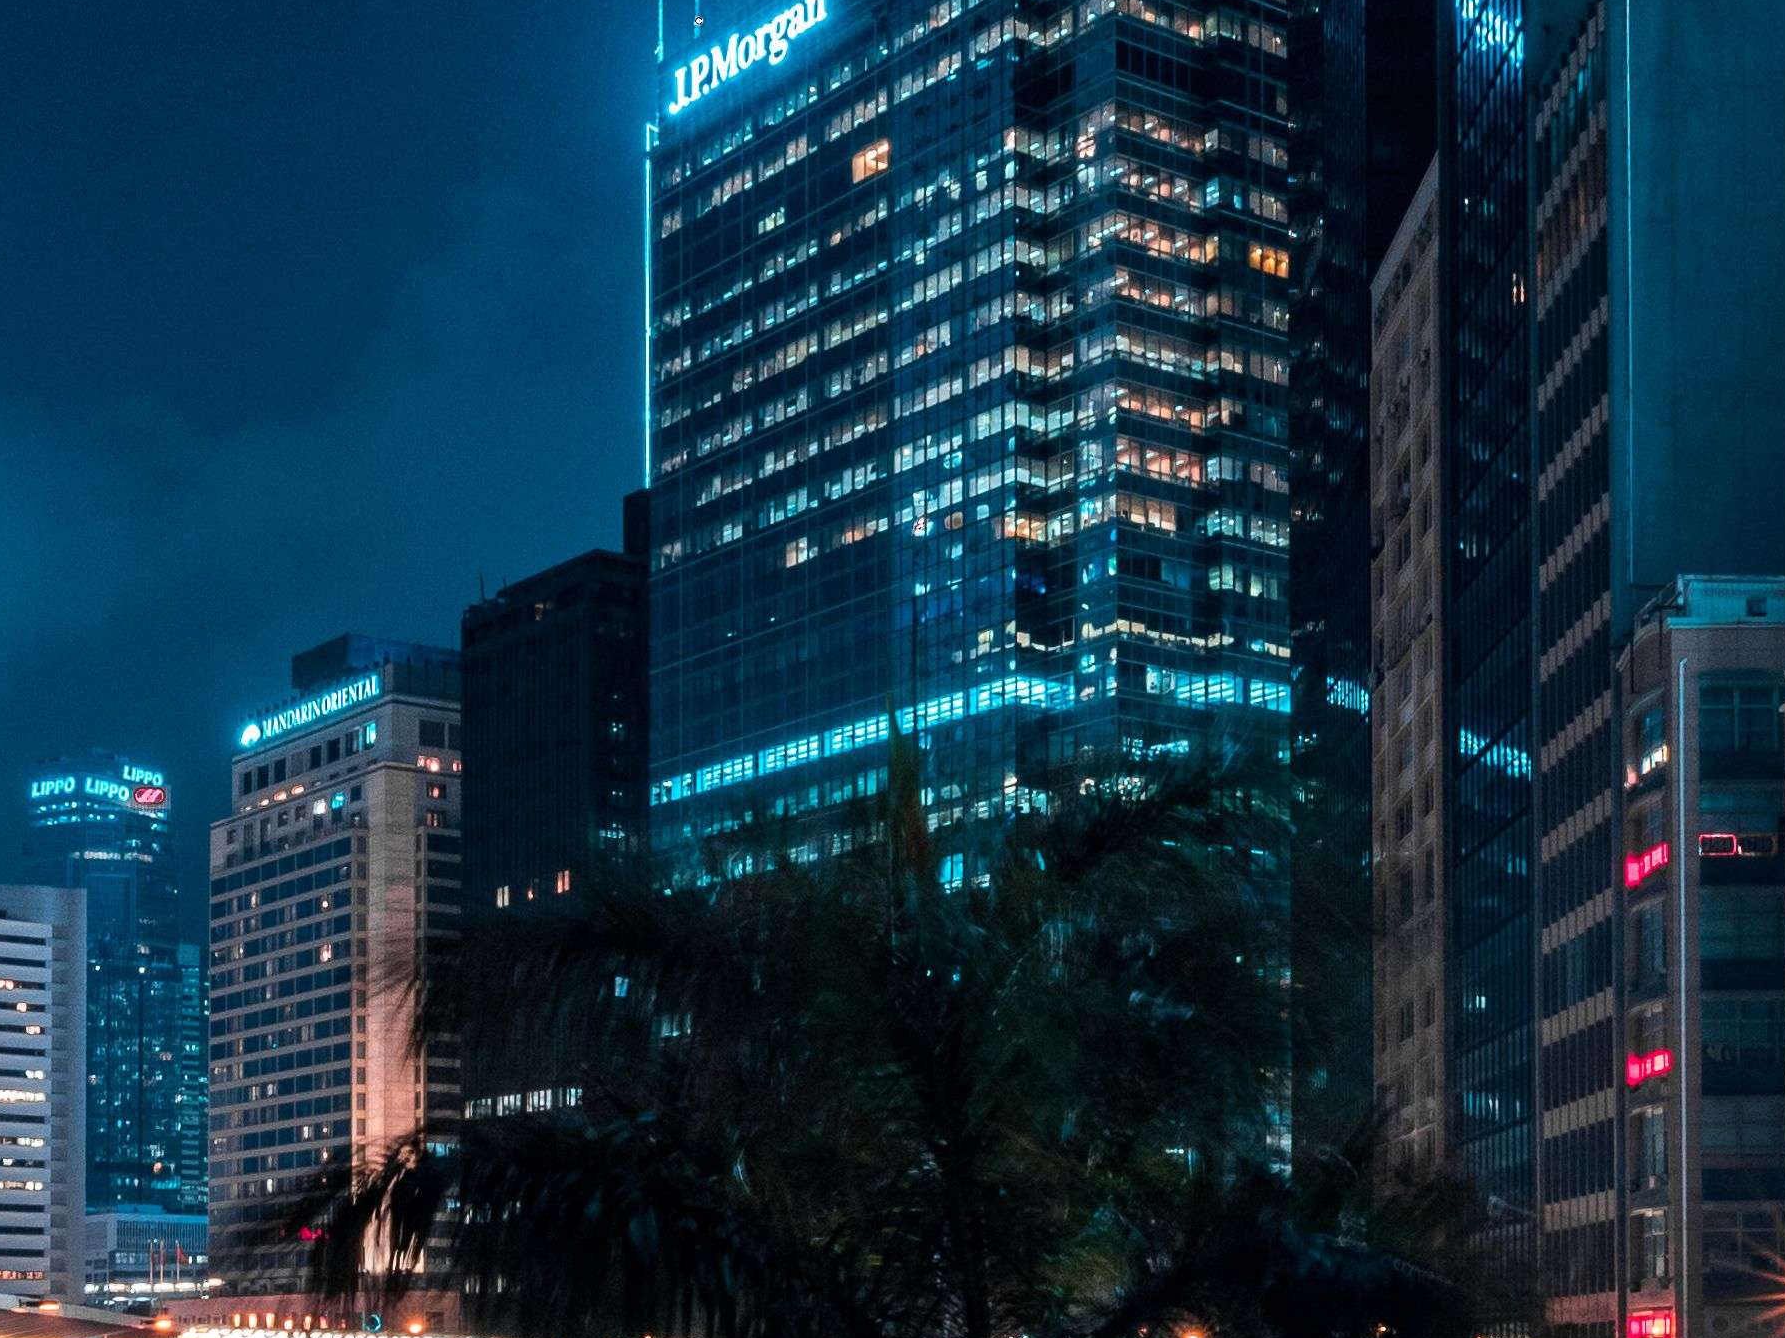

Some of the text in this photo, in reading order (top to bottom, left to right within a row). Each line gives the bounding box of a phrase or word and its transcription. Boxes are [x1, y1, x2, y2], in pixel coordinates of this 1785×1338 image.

[262, 674, 380, 740] MANDARIN ORIENTAL
[123, 765, 164, 786] LIPPO
[31, 776, 130, 801] LIPPO LIPPO
